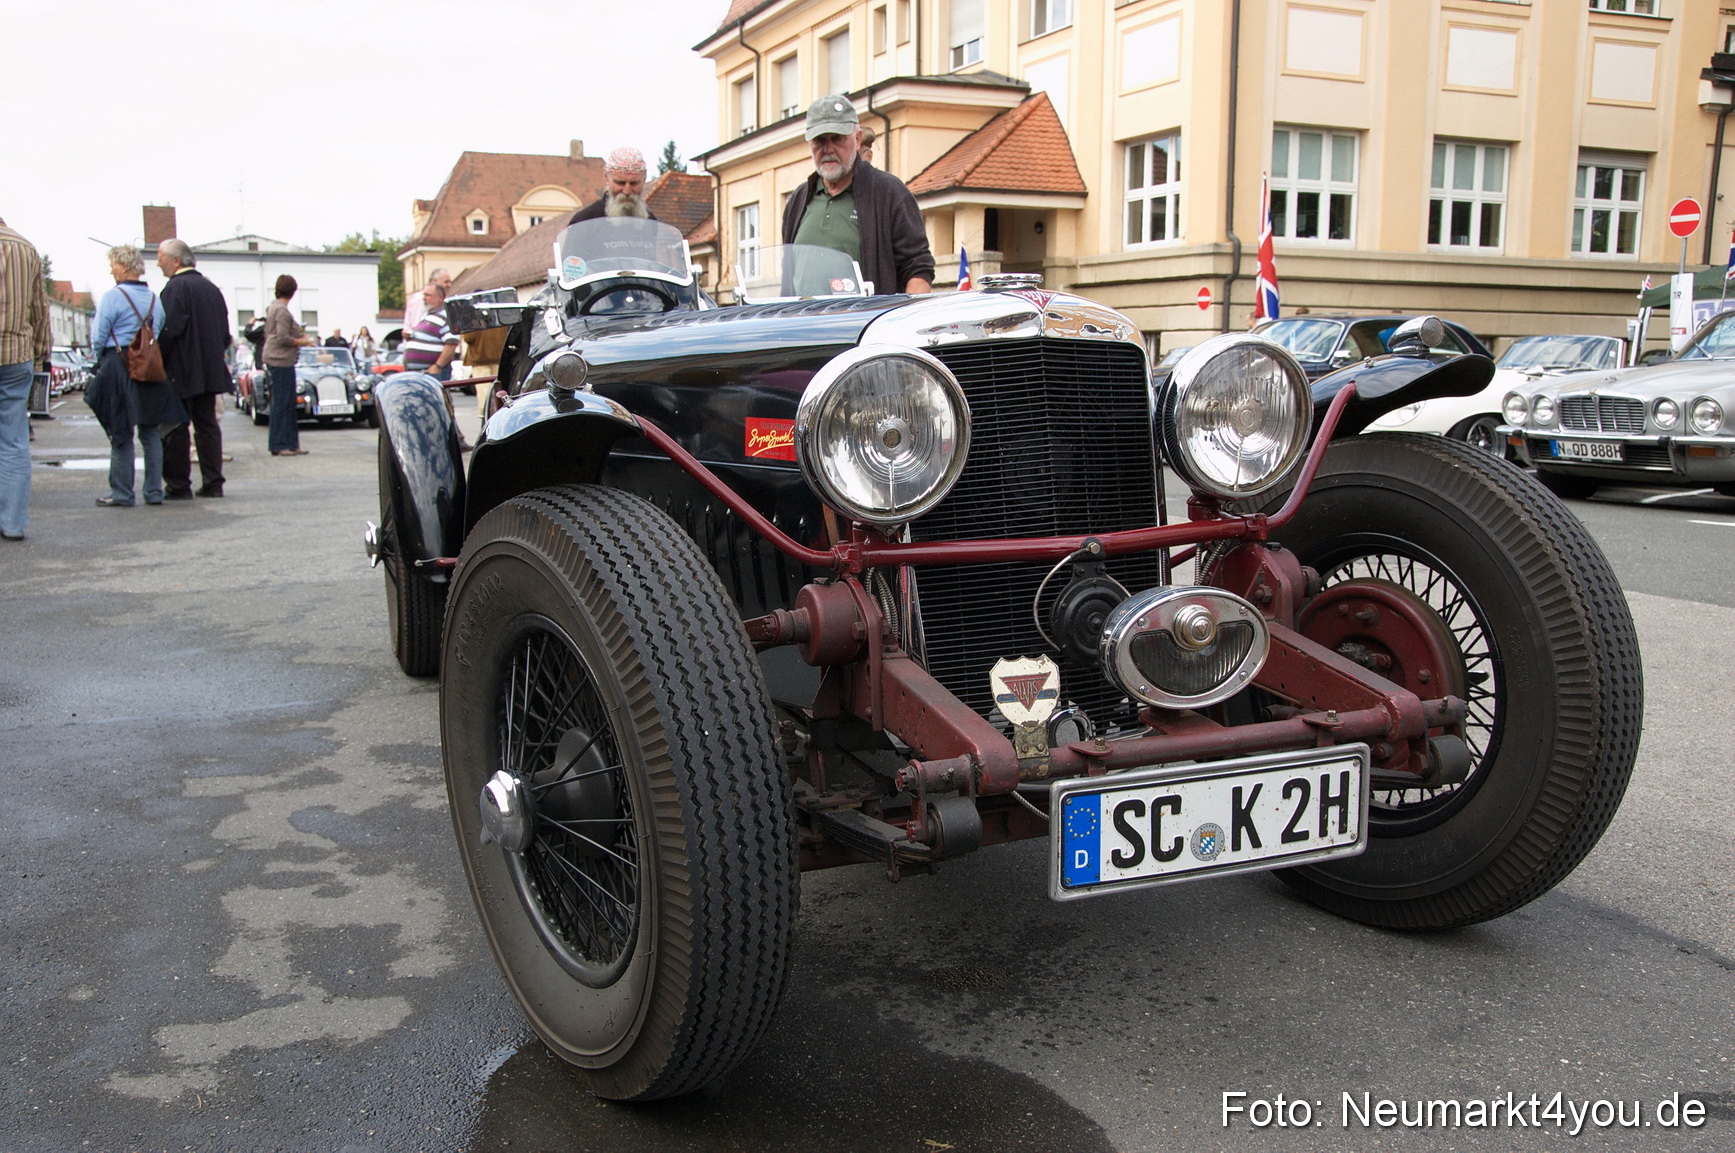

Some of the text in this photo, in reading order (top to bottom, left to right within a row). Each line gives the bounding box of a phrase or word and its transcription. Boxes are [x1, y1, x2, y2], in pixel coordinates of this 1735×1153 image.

[1557, 442, 1621, 458] N QD 888H
[1013, 680, 1038, 706] ALVIS
[1111, 770, 1350, 869] SC K 2H
[1074, 849, 1089, 869] D
